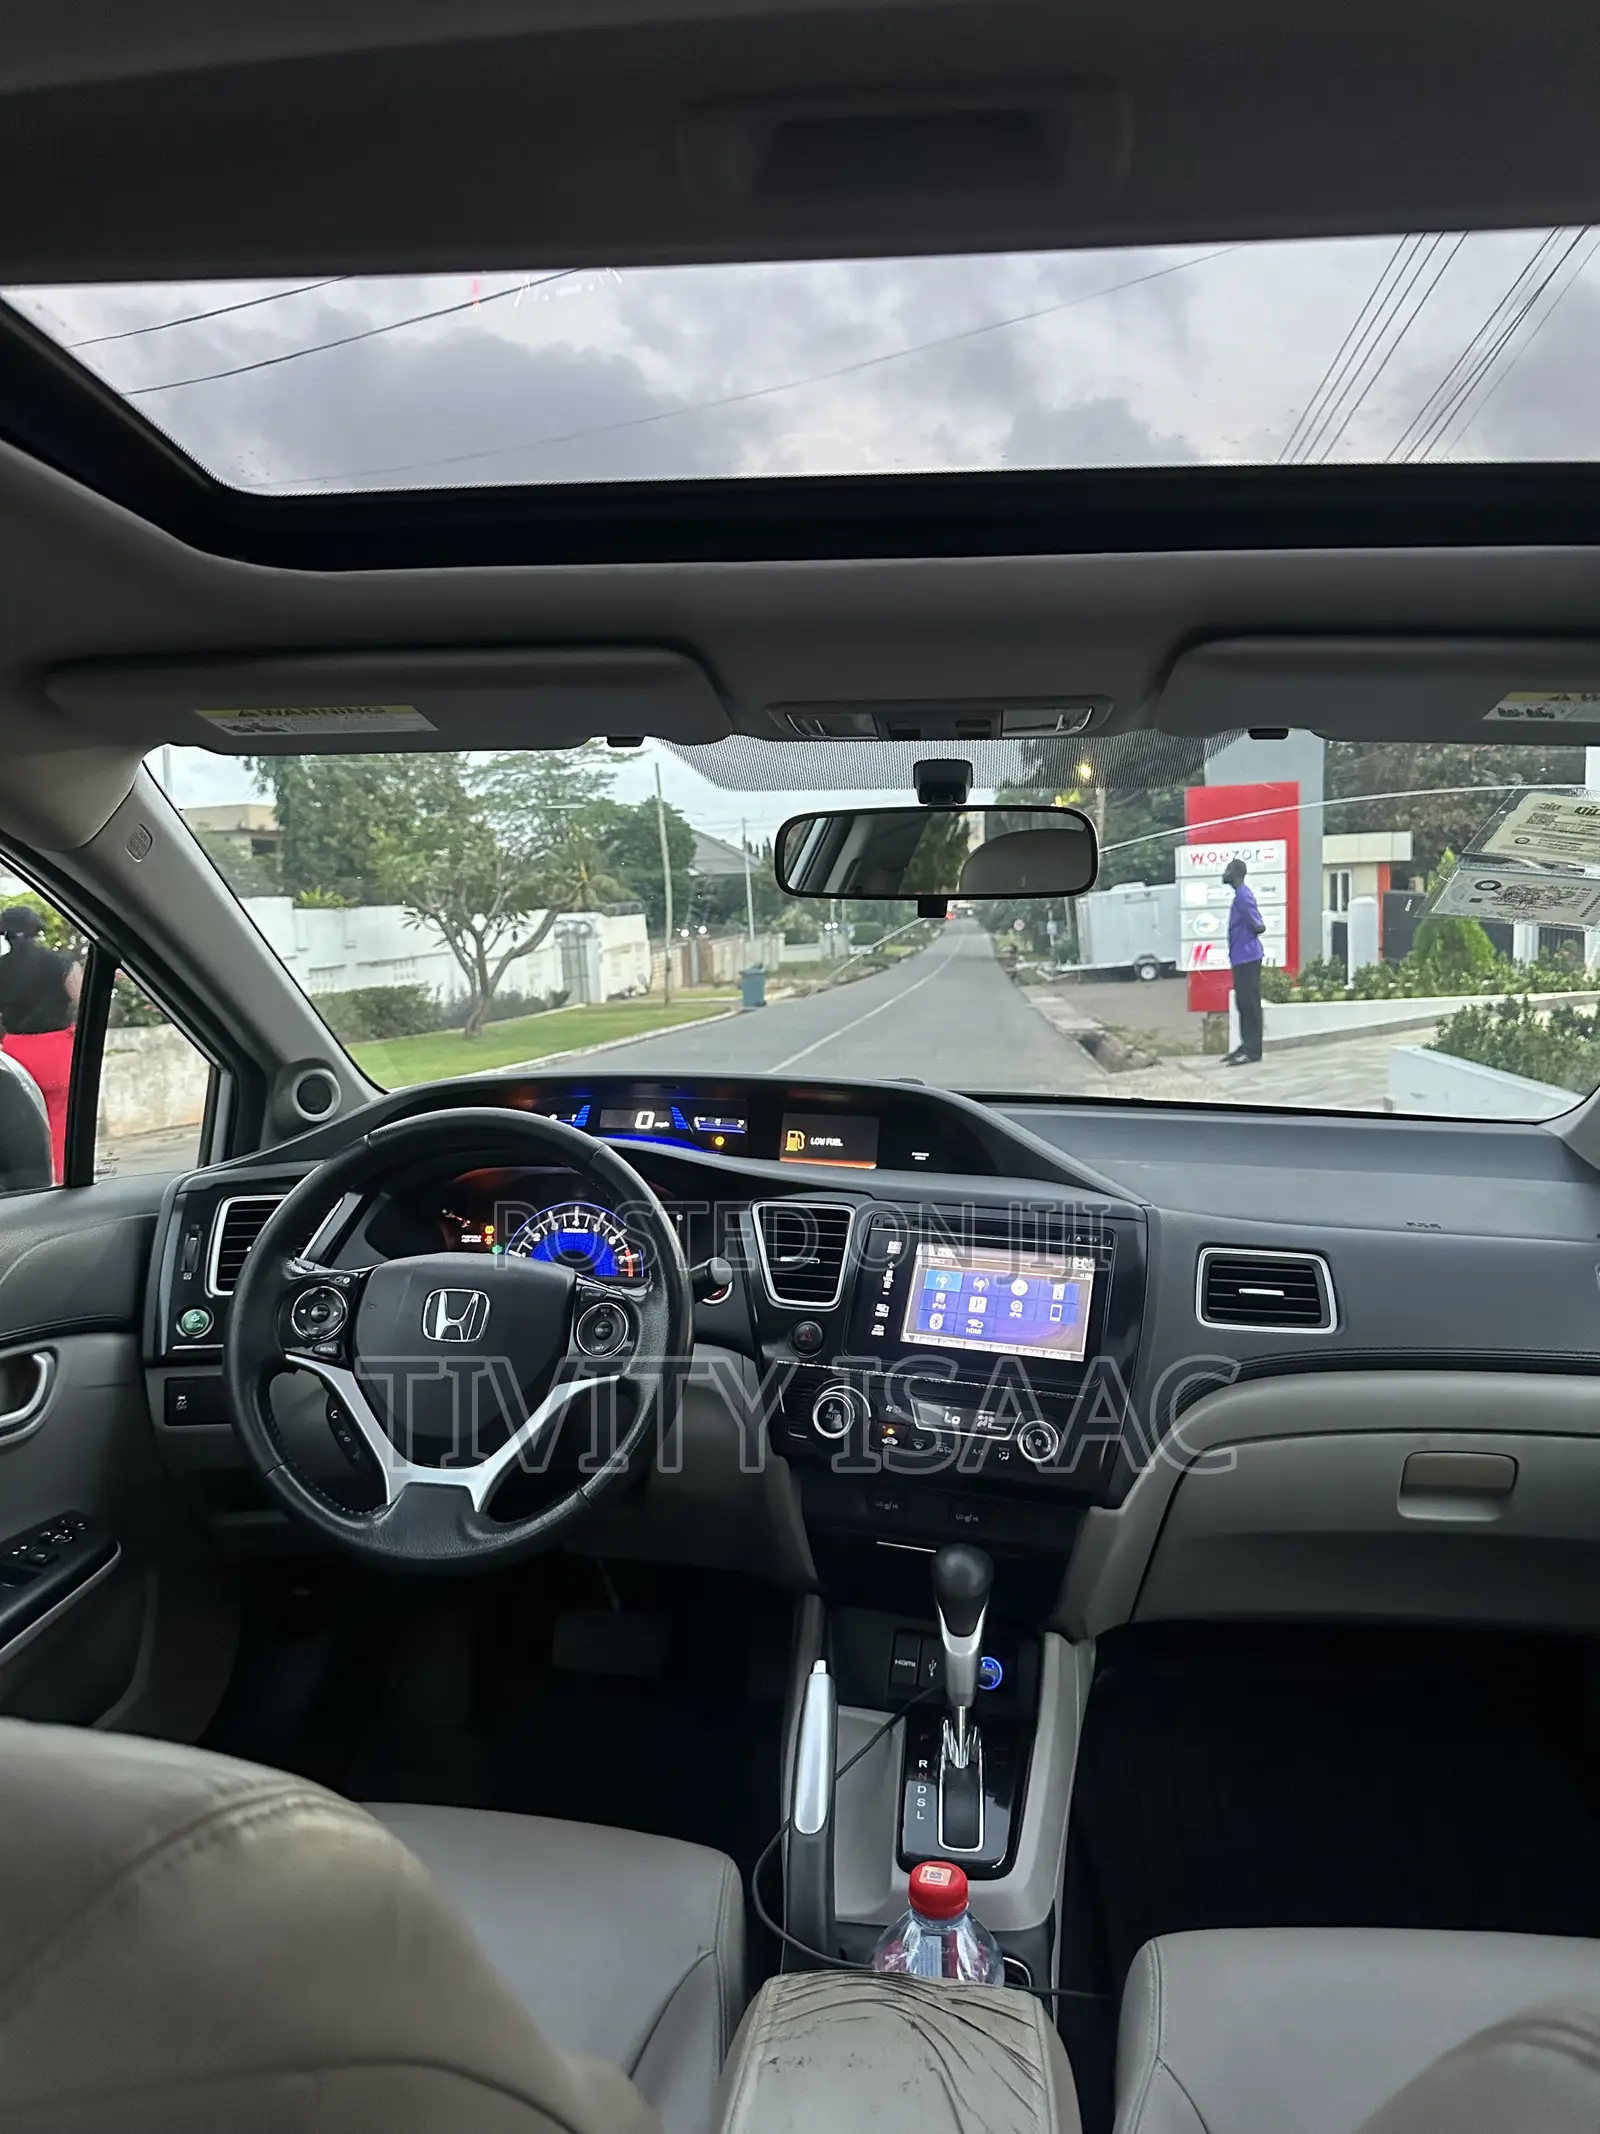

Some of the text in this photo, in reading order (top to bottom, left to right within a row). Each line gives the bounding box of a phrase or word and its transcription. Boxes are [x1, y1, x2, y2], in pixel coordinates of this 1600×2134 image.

[261, 706, 386, 717] WARNING
[810, 1137, 843, 1147] LOW FUEL
[966, 1327, 983, 1335] HDMI
[320, 1345, 336, 1353] MENU
[918, 1759, 928, 1768] R
[917, 1785, 927, 1794] D
[916, 1798, 926, 1807] S
[916, 1810, 924, 1820] L
